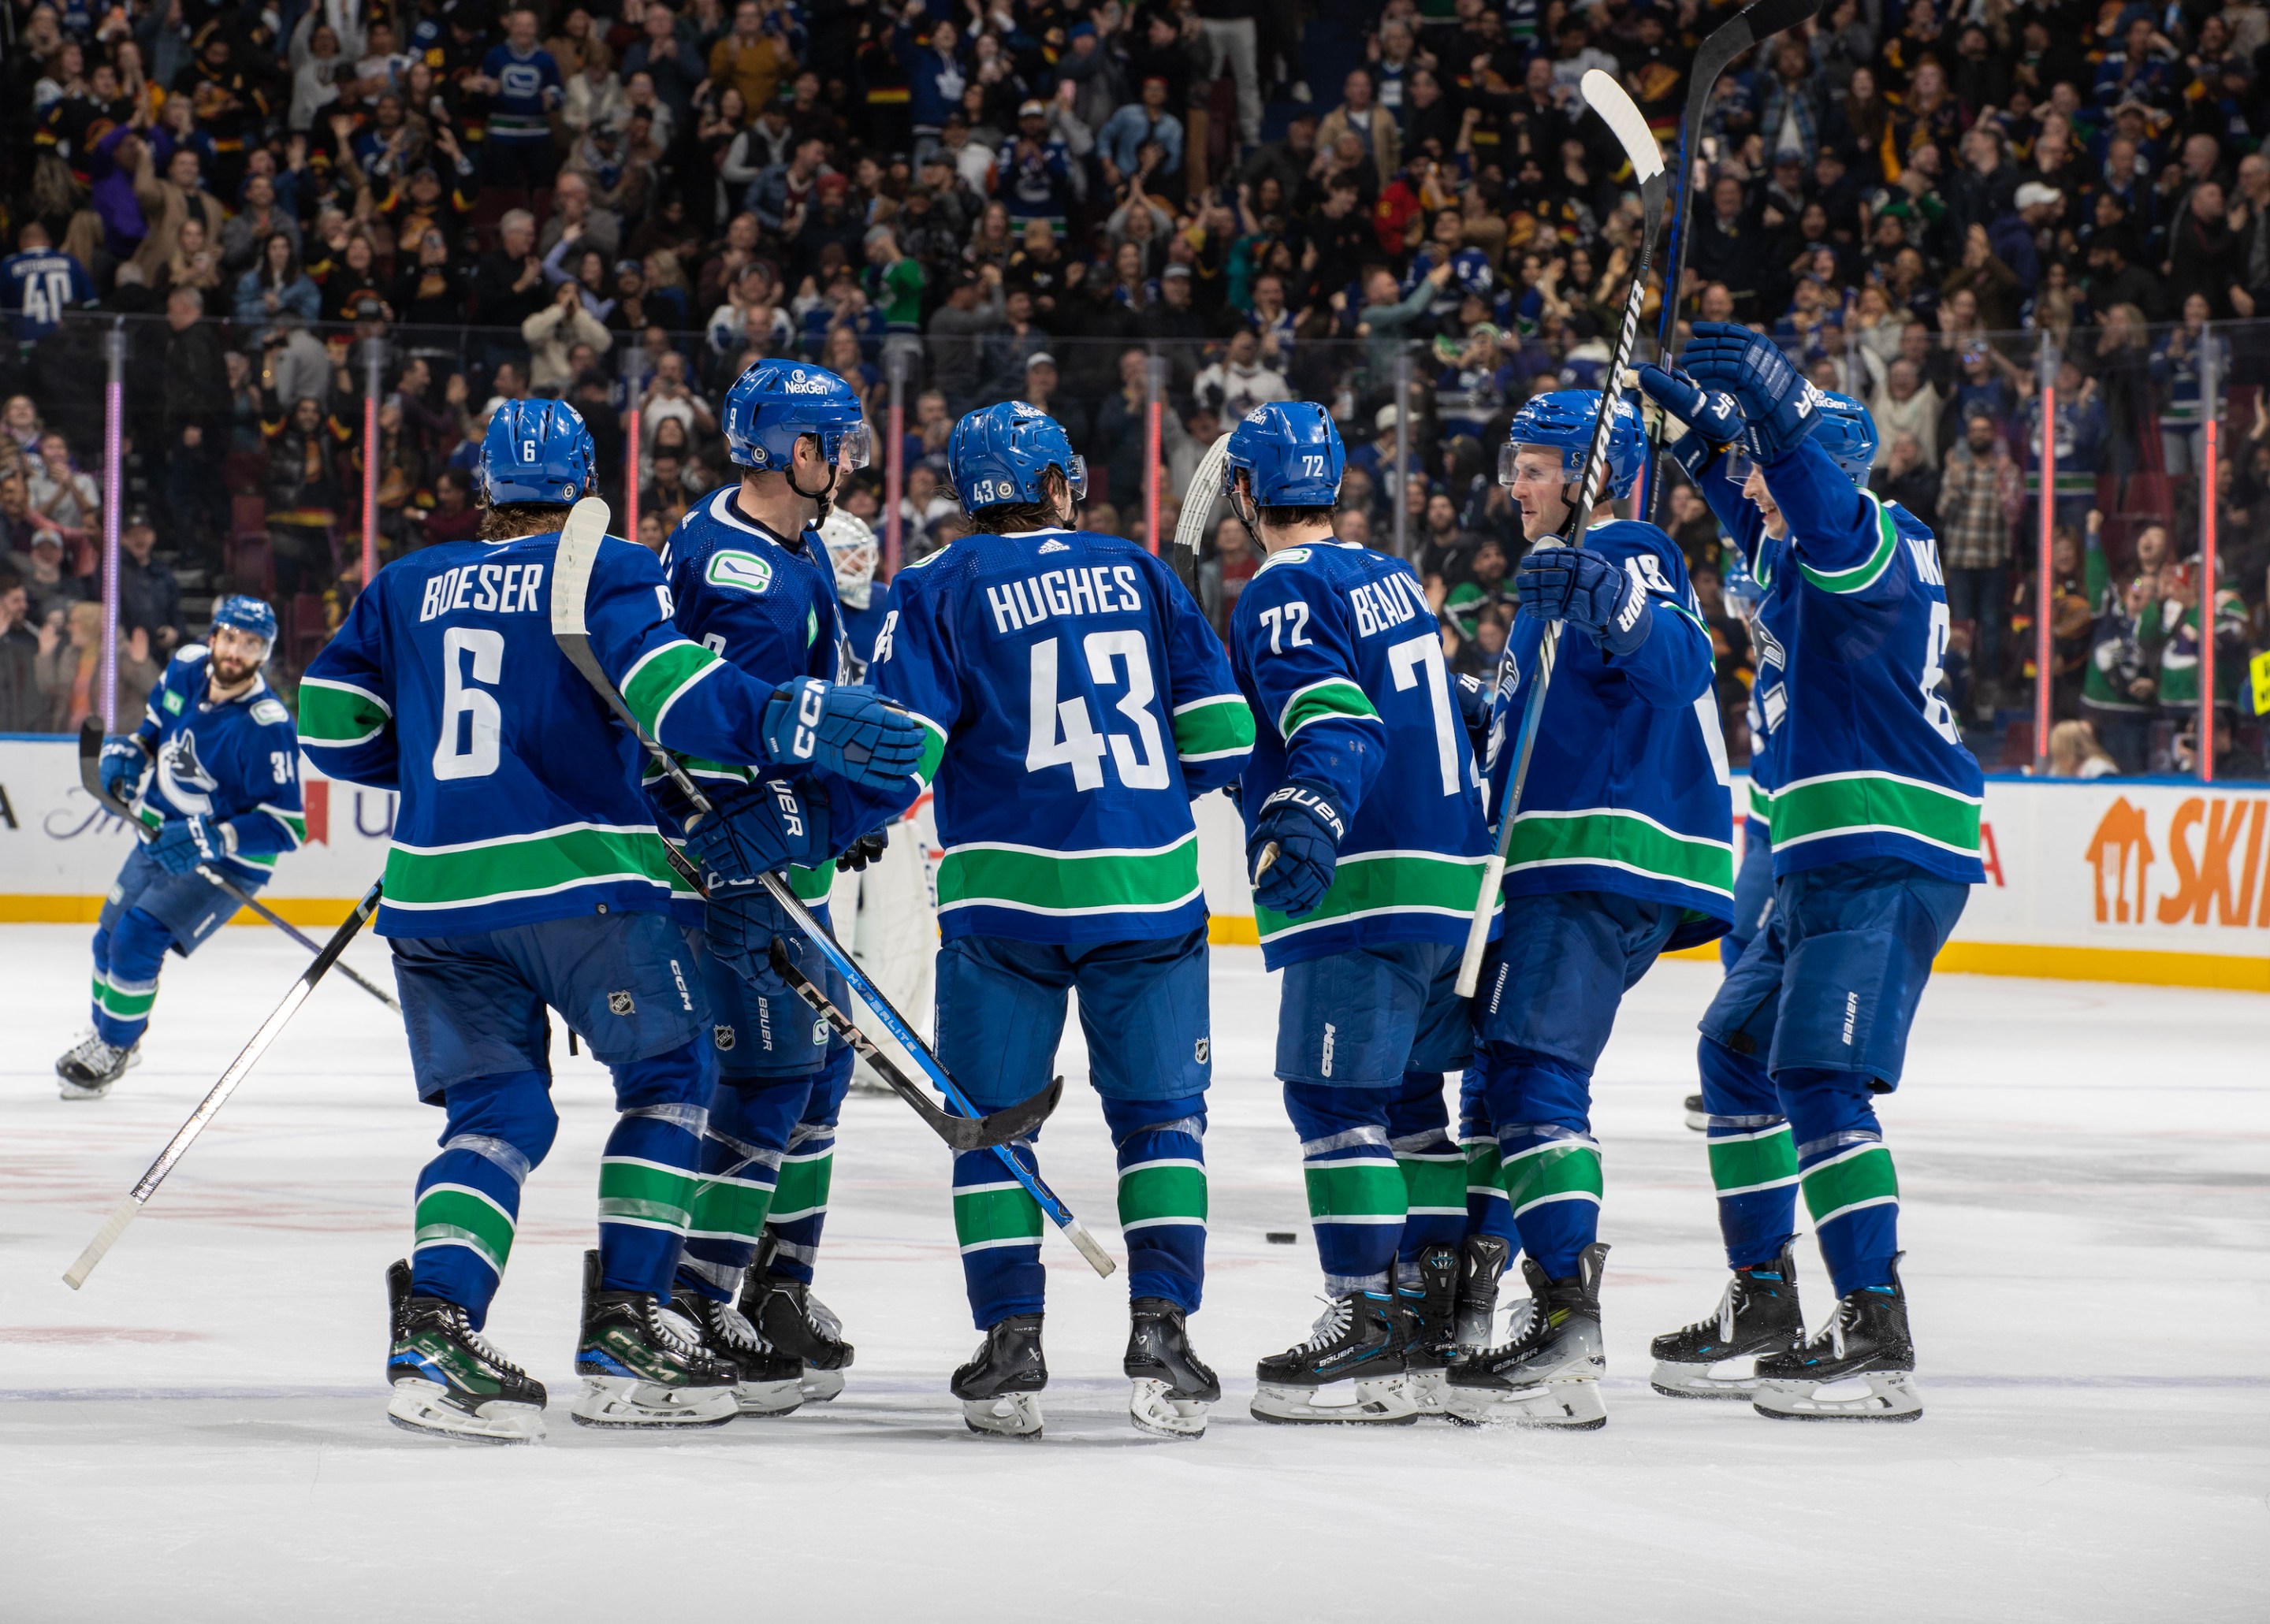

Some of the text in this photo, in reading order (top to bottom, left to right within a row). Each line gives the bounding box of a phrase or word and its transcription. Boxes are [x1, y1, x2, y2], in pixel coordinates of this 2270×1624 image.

[22, 271, 73, 324] 40
[785, 381, 828, 395] NexGen
[1814, 397, 1848, 411] exGen
[730, 407, 737, 429] 9
[523, 440, 535, 463] 6
[1302, 455, 1324, 478] 72
[973, 479, 995, 504] 43
[1038, 544, 1070, 555] adidas
[419, 563, 544, 622] BOESER
[986, 565, 1142, 634] HUGHES
[1349, 571, 1437, 638] BEAUV
[1259, 600, 1313, 655] 72
[432, 626, 505, 781] 6
[1025, 630, 1170, 793] 43
[670, 959, 694, 1012] CCM
[1489, 961, 1509, 1015] WARRIOR
[757, 995, 773, 1052] BAUER
[1842, 990, 1859, 1046] BAUER
[1321, 1022, 1336, 1078] CCM
[605, 1329, 678, 1381] CCM
[1319, 1347, 1355, 1368] BAUER
[1492, 1347, 1539, 1373] BAUER
